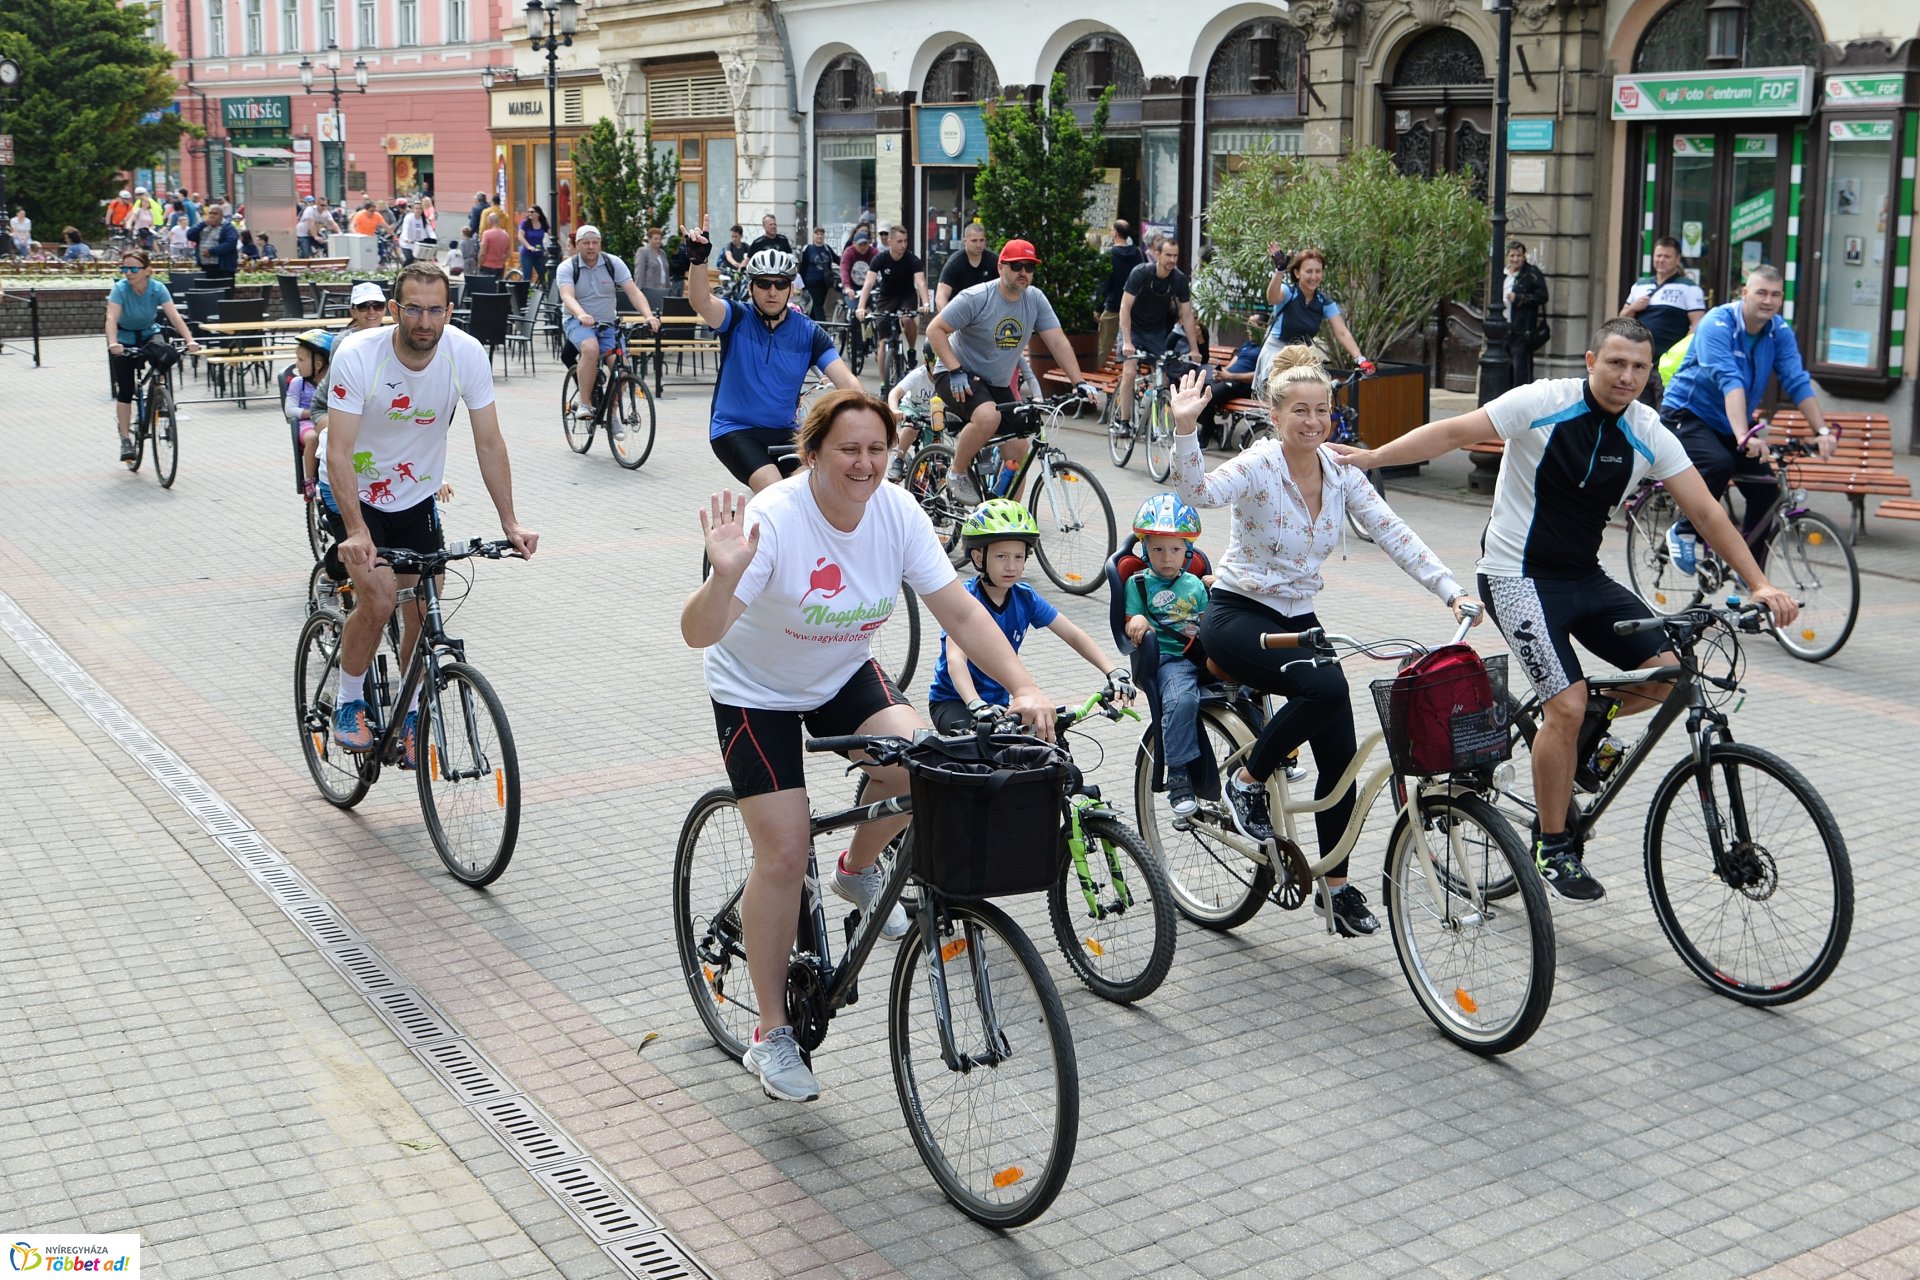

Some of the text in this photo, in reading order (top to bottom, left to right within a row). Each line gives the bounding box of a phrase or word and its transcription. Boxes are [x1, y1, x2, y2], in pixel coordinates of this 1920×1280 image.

[1658, 85, 1752, 105] Fuji Foto Centrum
[1758, 82, 1794, 100] FDF
[1877, 83, 1899, 95] FDF
[228, 98, 282, 119] NYÍRSÉG
[508, 101, 543, 115] MARELLA
[1872, 124, 1889, 134] FDF
[1745, 140, 1764, 150] FDF
[802, 597, 894, 629] Nagykálló
[1520, 645, 1548, 683] eybl
[847, 849, 900, 963] MERIDA
[931, 977, 944, 1021] MERIDA
